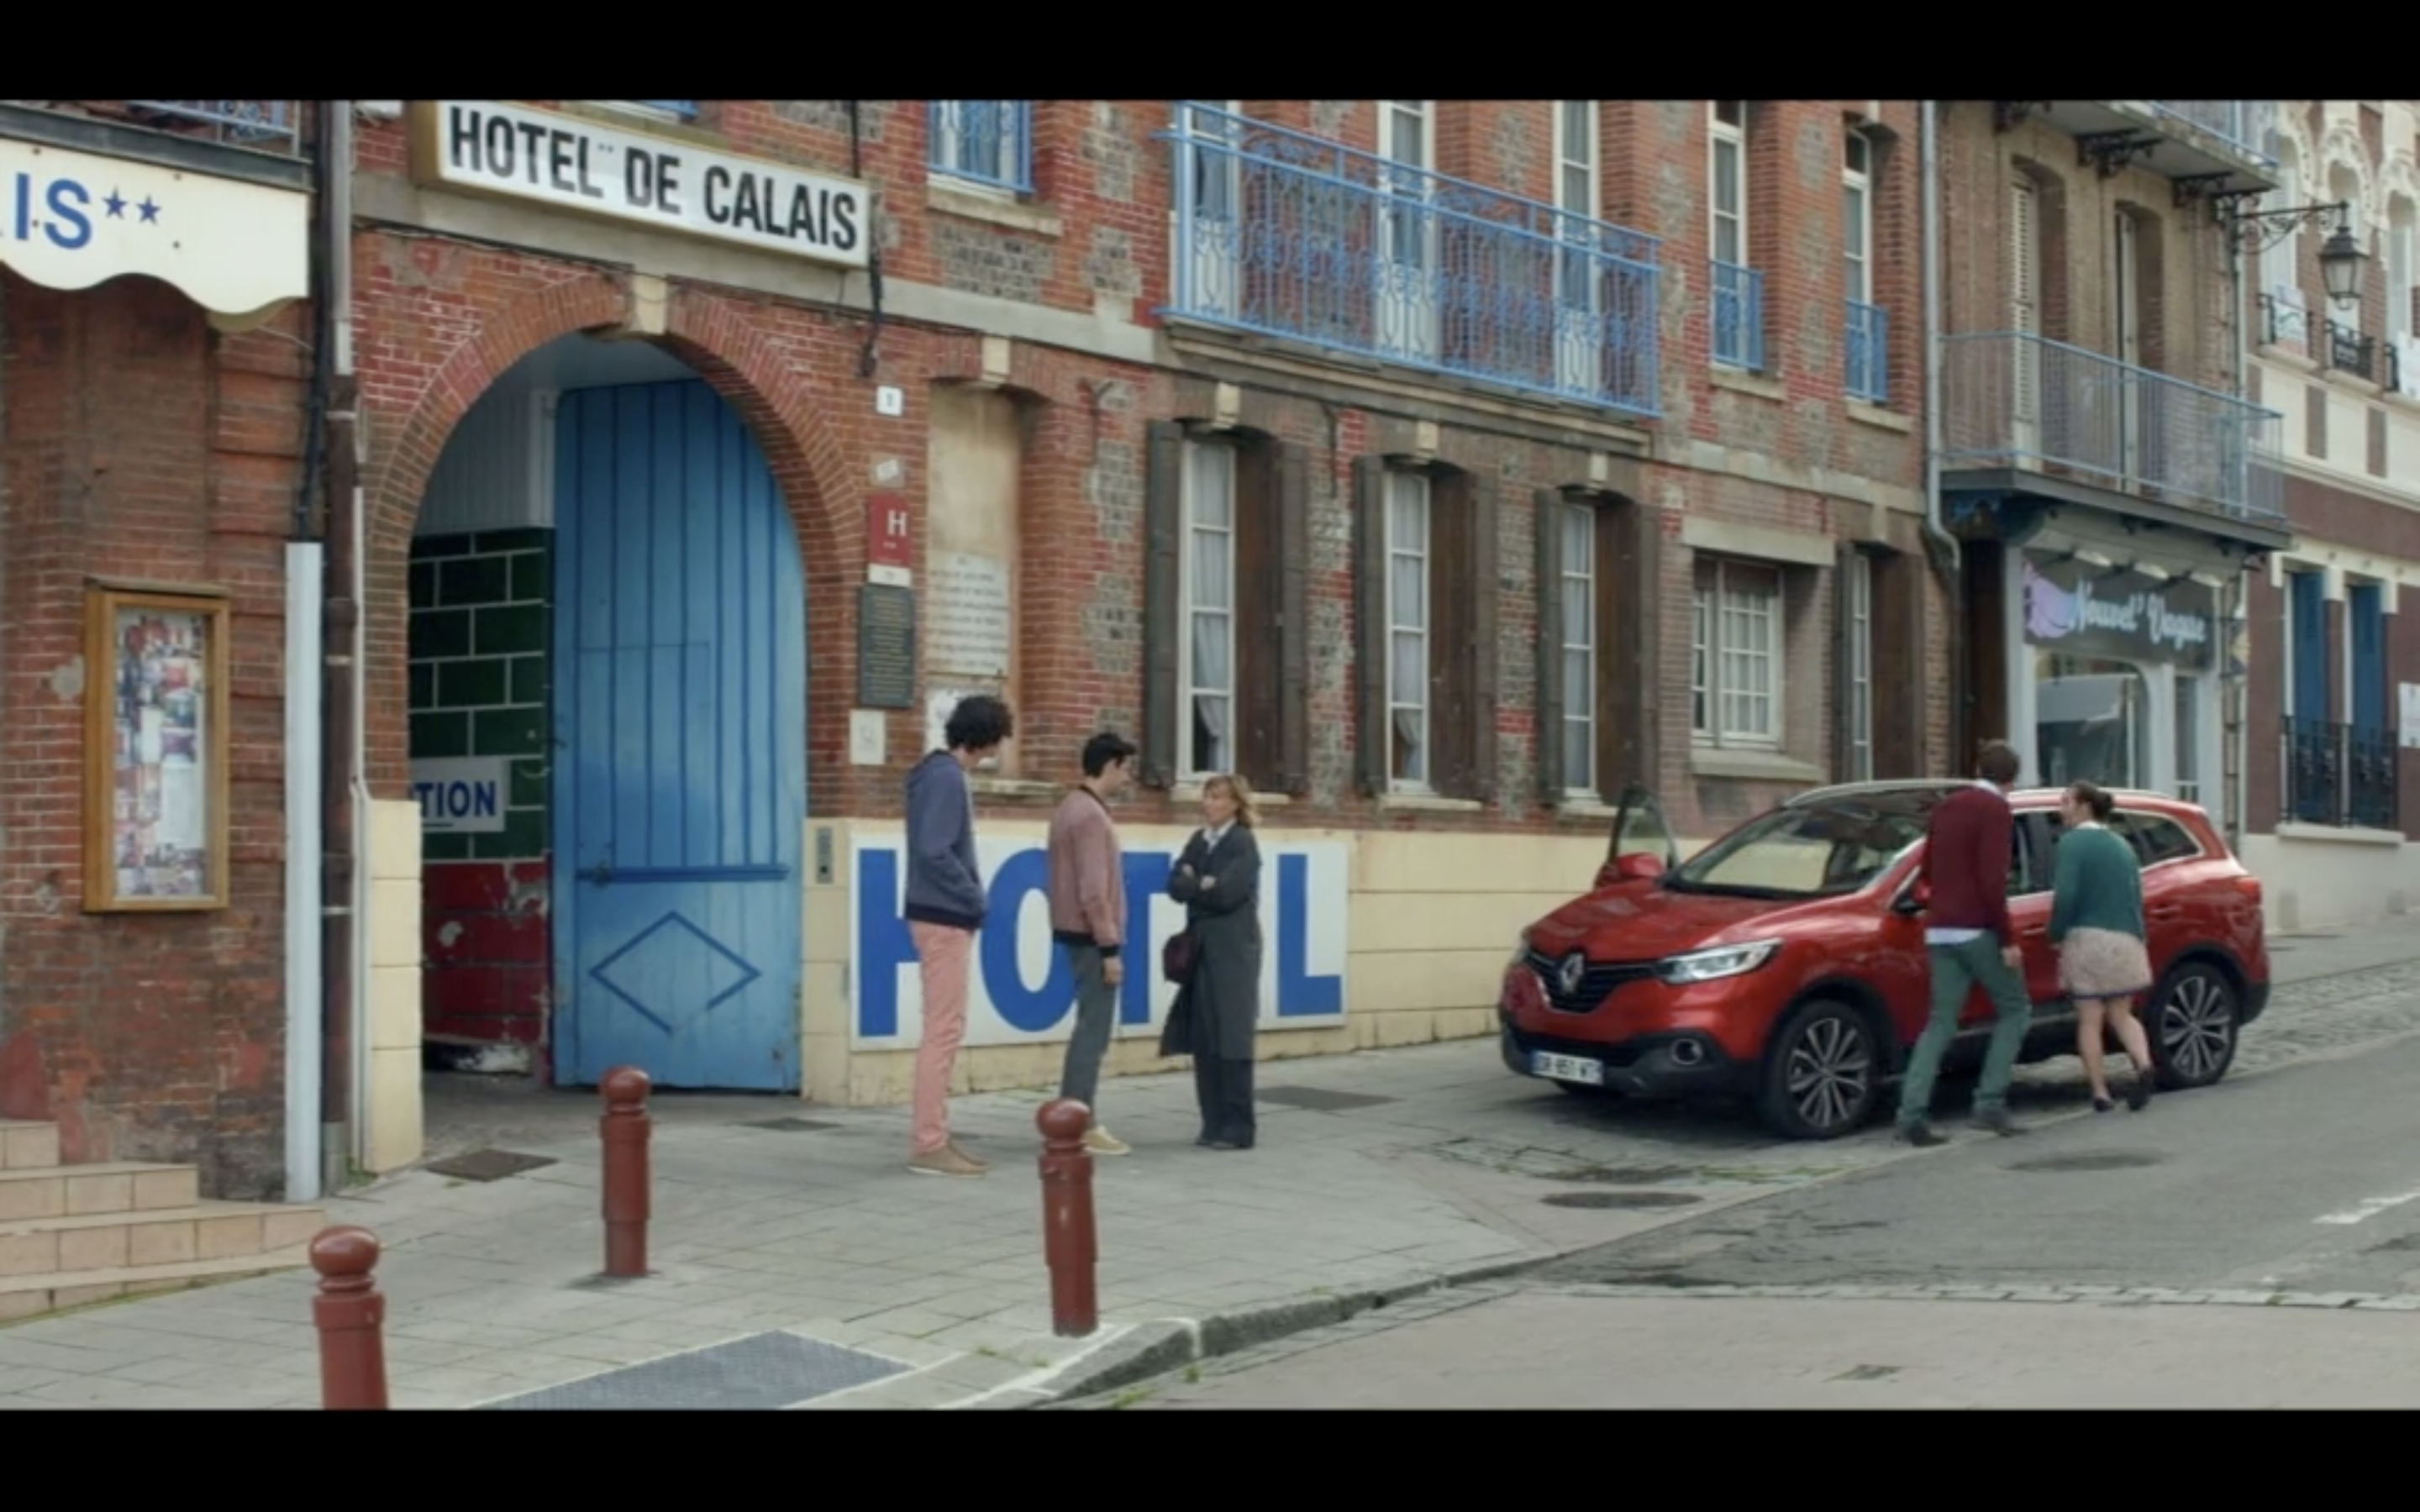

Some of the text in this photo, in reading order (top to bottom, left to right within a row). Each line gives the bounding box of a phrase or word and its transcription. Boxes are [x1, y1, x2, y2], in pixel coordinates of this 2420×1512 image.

[449, 108, 859, 251] HOTEL DE CALAIS
[887, 510, 908, 537] H
[414, 780, 496, 818] TION
[858, 847, 1343, 1037] HOTL
